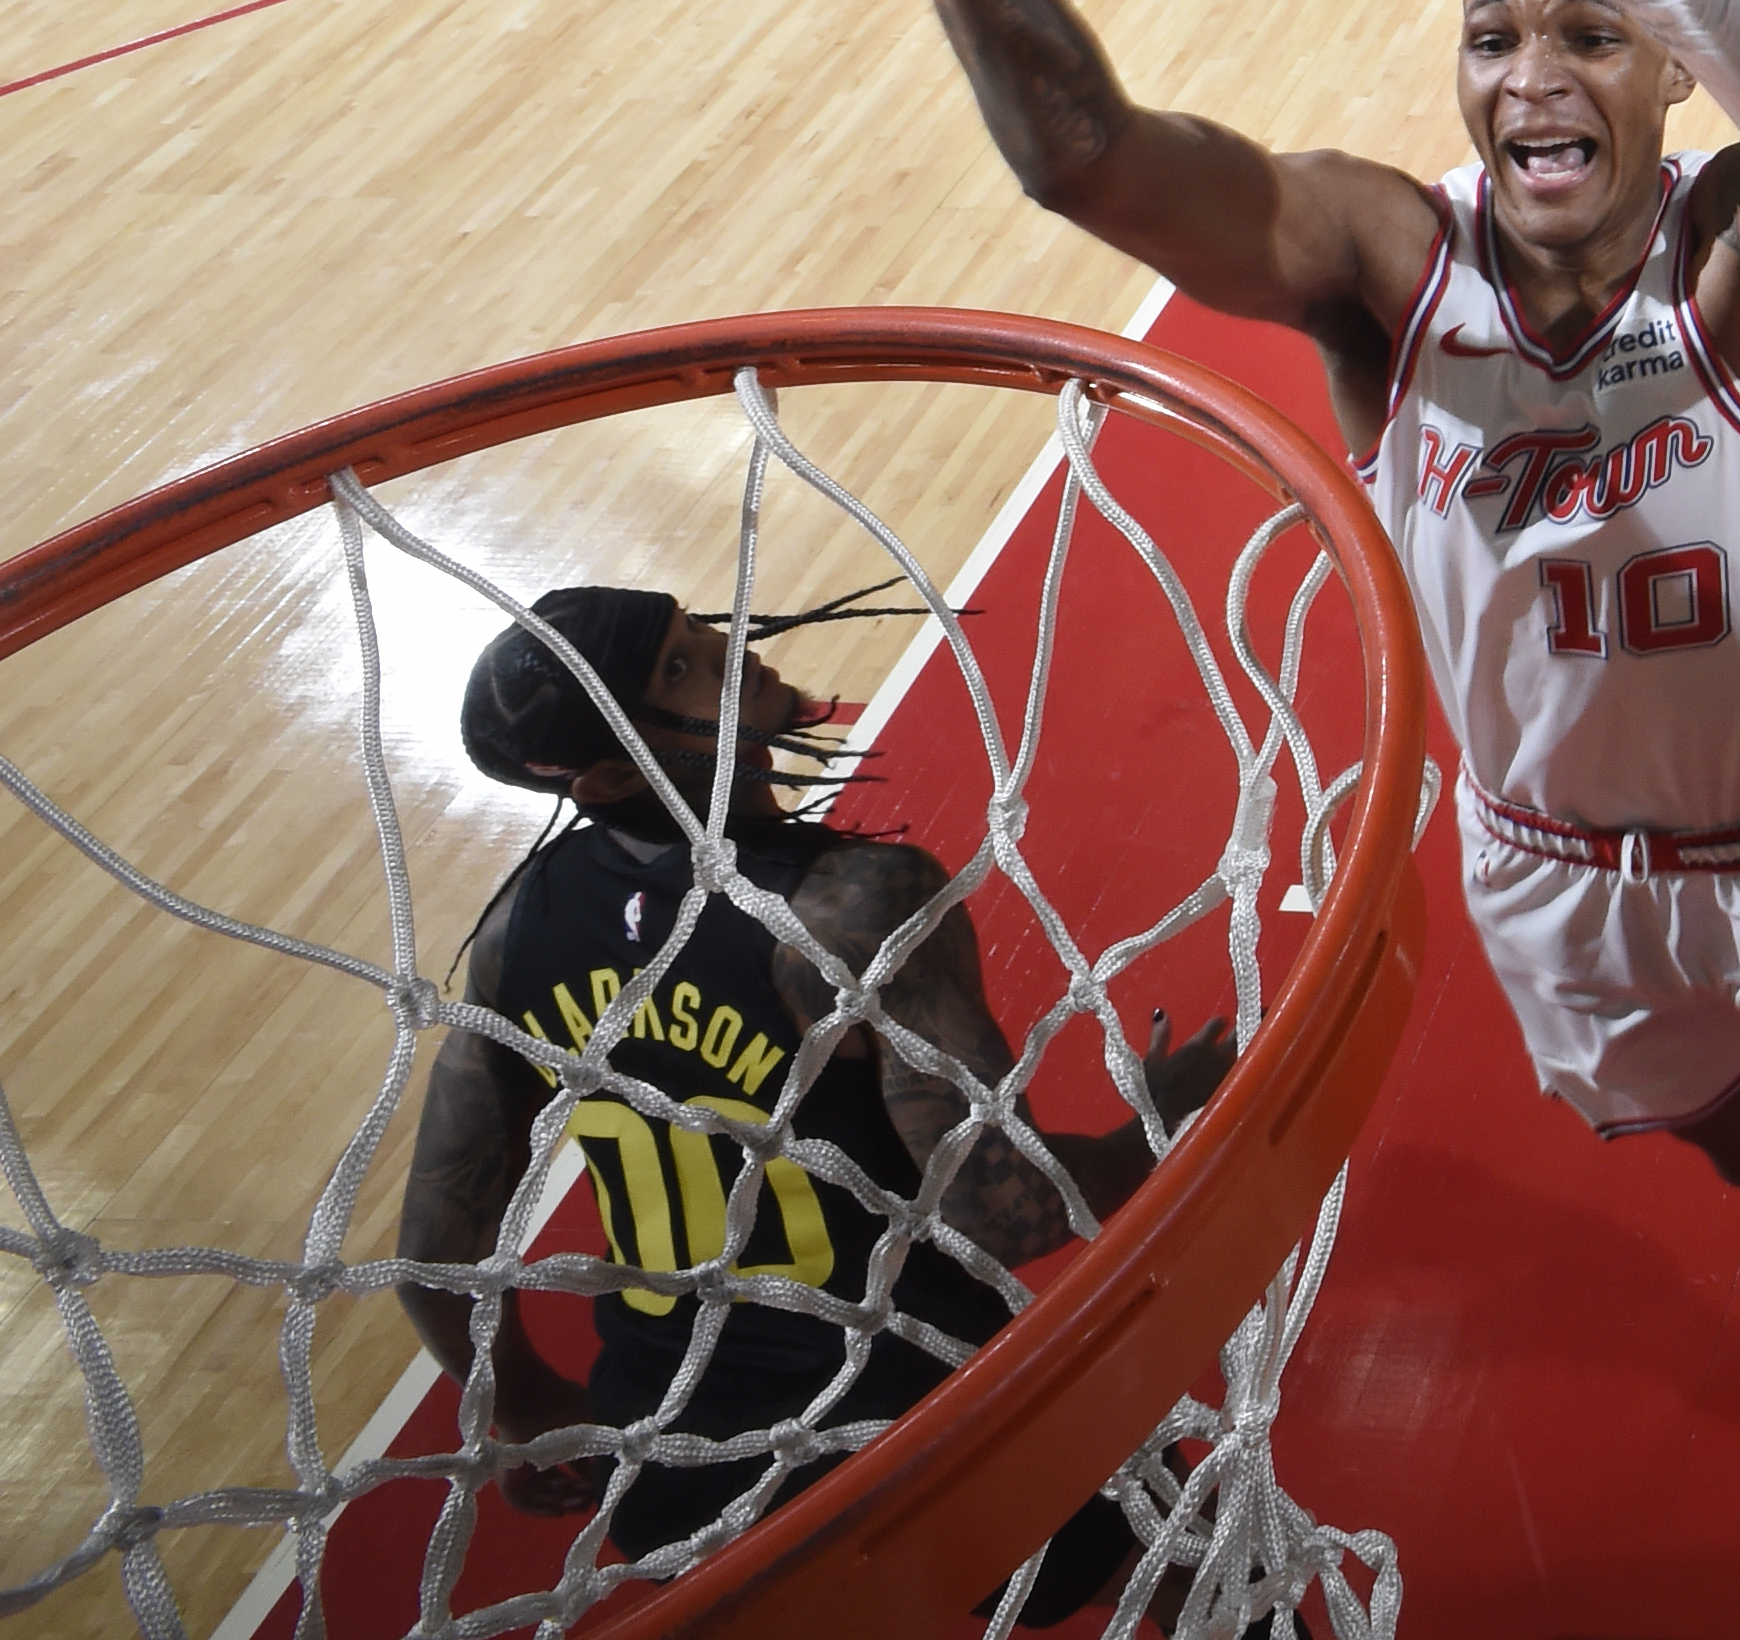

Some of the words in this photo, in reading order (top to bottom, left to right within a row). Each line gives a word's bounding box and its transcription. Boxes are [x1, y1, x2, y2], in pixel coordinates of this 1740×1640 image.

[1598, 350, 1685, 391] karma
[1418, 415, 1714, 534] H-Town
[1538, 540, 1732, 660] 10
